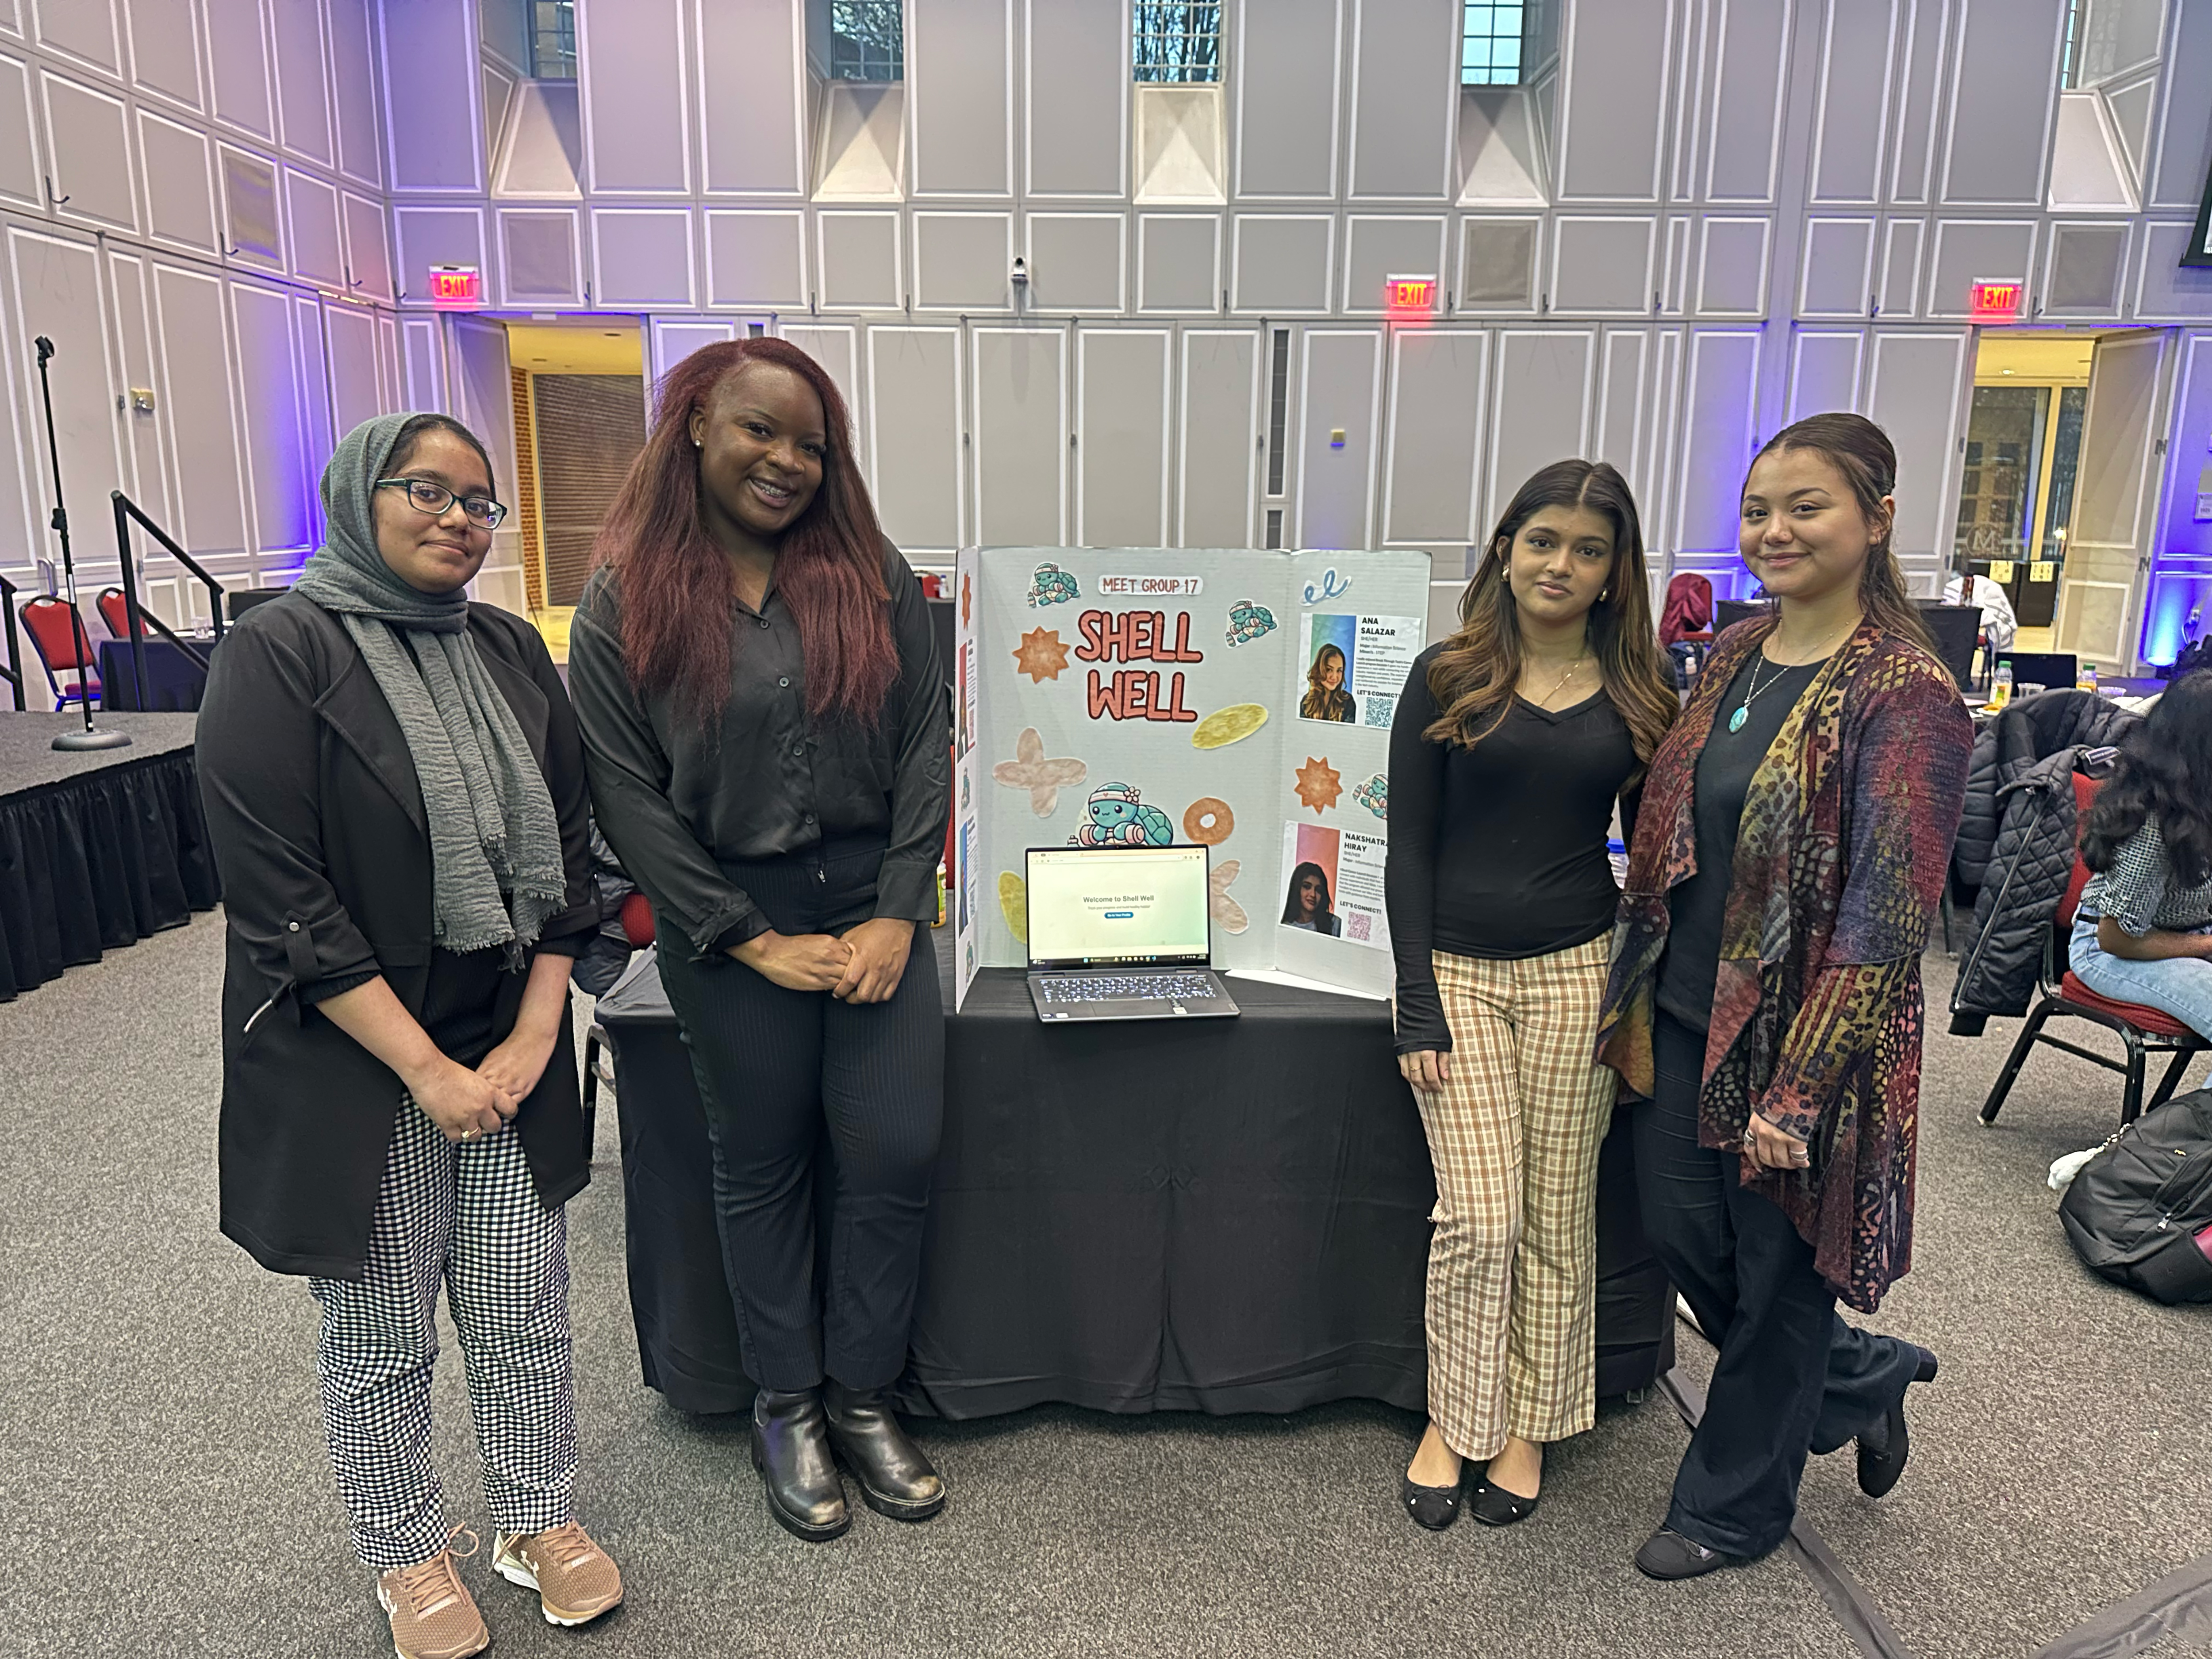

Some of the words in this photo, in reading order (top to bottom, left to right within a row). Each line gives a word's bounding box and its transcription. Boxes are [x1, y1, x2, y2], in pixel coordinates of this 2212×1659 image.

[440, 275, 469, 296] EXIT
[1397, 283, 1427, 304] EXIT
[1982, 287, 2013, 307] EXIT
[1103, 577, 1137, 593] MEET
[1141, 579, 1179, 593] GROUP
[1185, 579, 1198, 594] 17
[1075, 610, 1203, 664] SHELL
[1361, 627, 1395, 636] SALAZAR
[1087, 669, 1198, 722] WELL
[1344, 842, 1367, 852] HIRAY
[1345, 833, 1387, 846] NAKSHATR
[1354, 904, 1381, 914] CONNECT!
